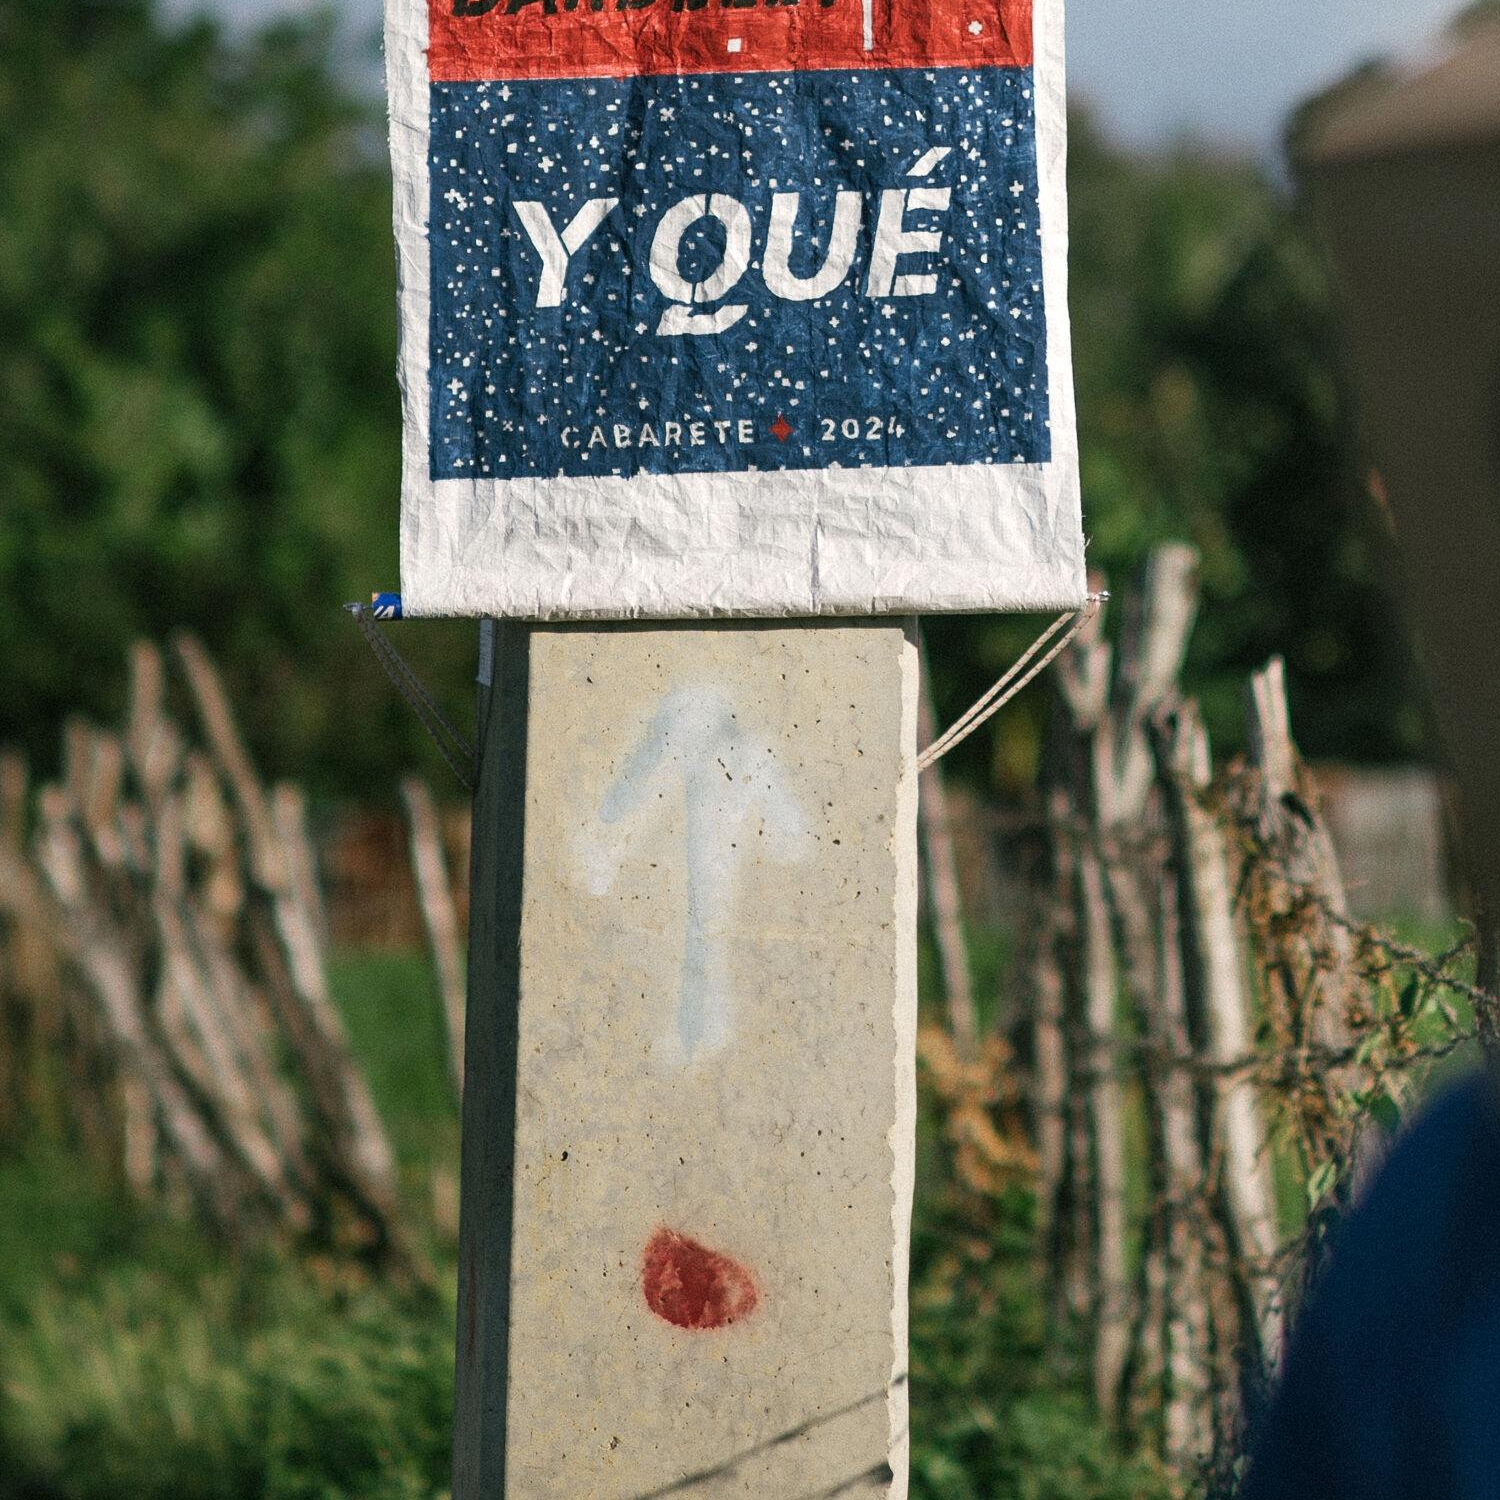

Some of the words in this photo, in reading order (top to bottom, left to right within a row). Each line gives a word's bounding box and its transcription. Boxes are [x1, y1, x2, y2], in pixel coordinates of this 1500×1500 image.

[512, 196, 619, 308] Y
[648, 146, 953, 337] QUÉ
[560, 419, 755, 449] CABARETE
[820, 415, 905, 441] 2024
